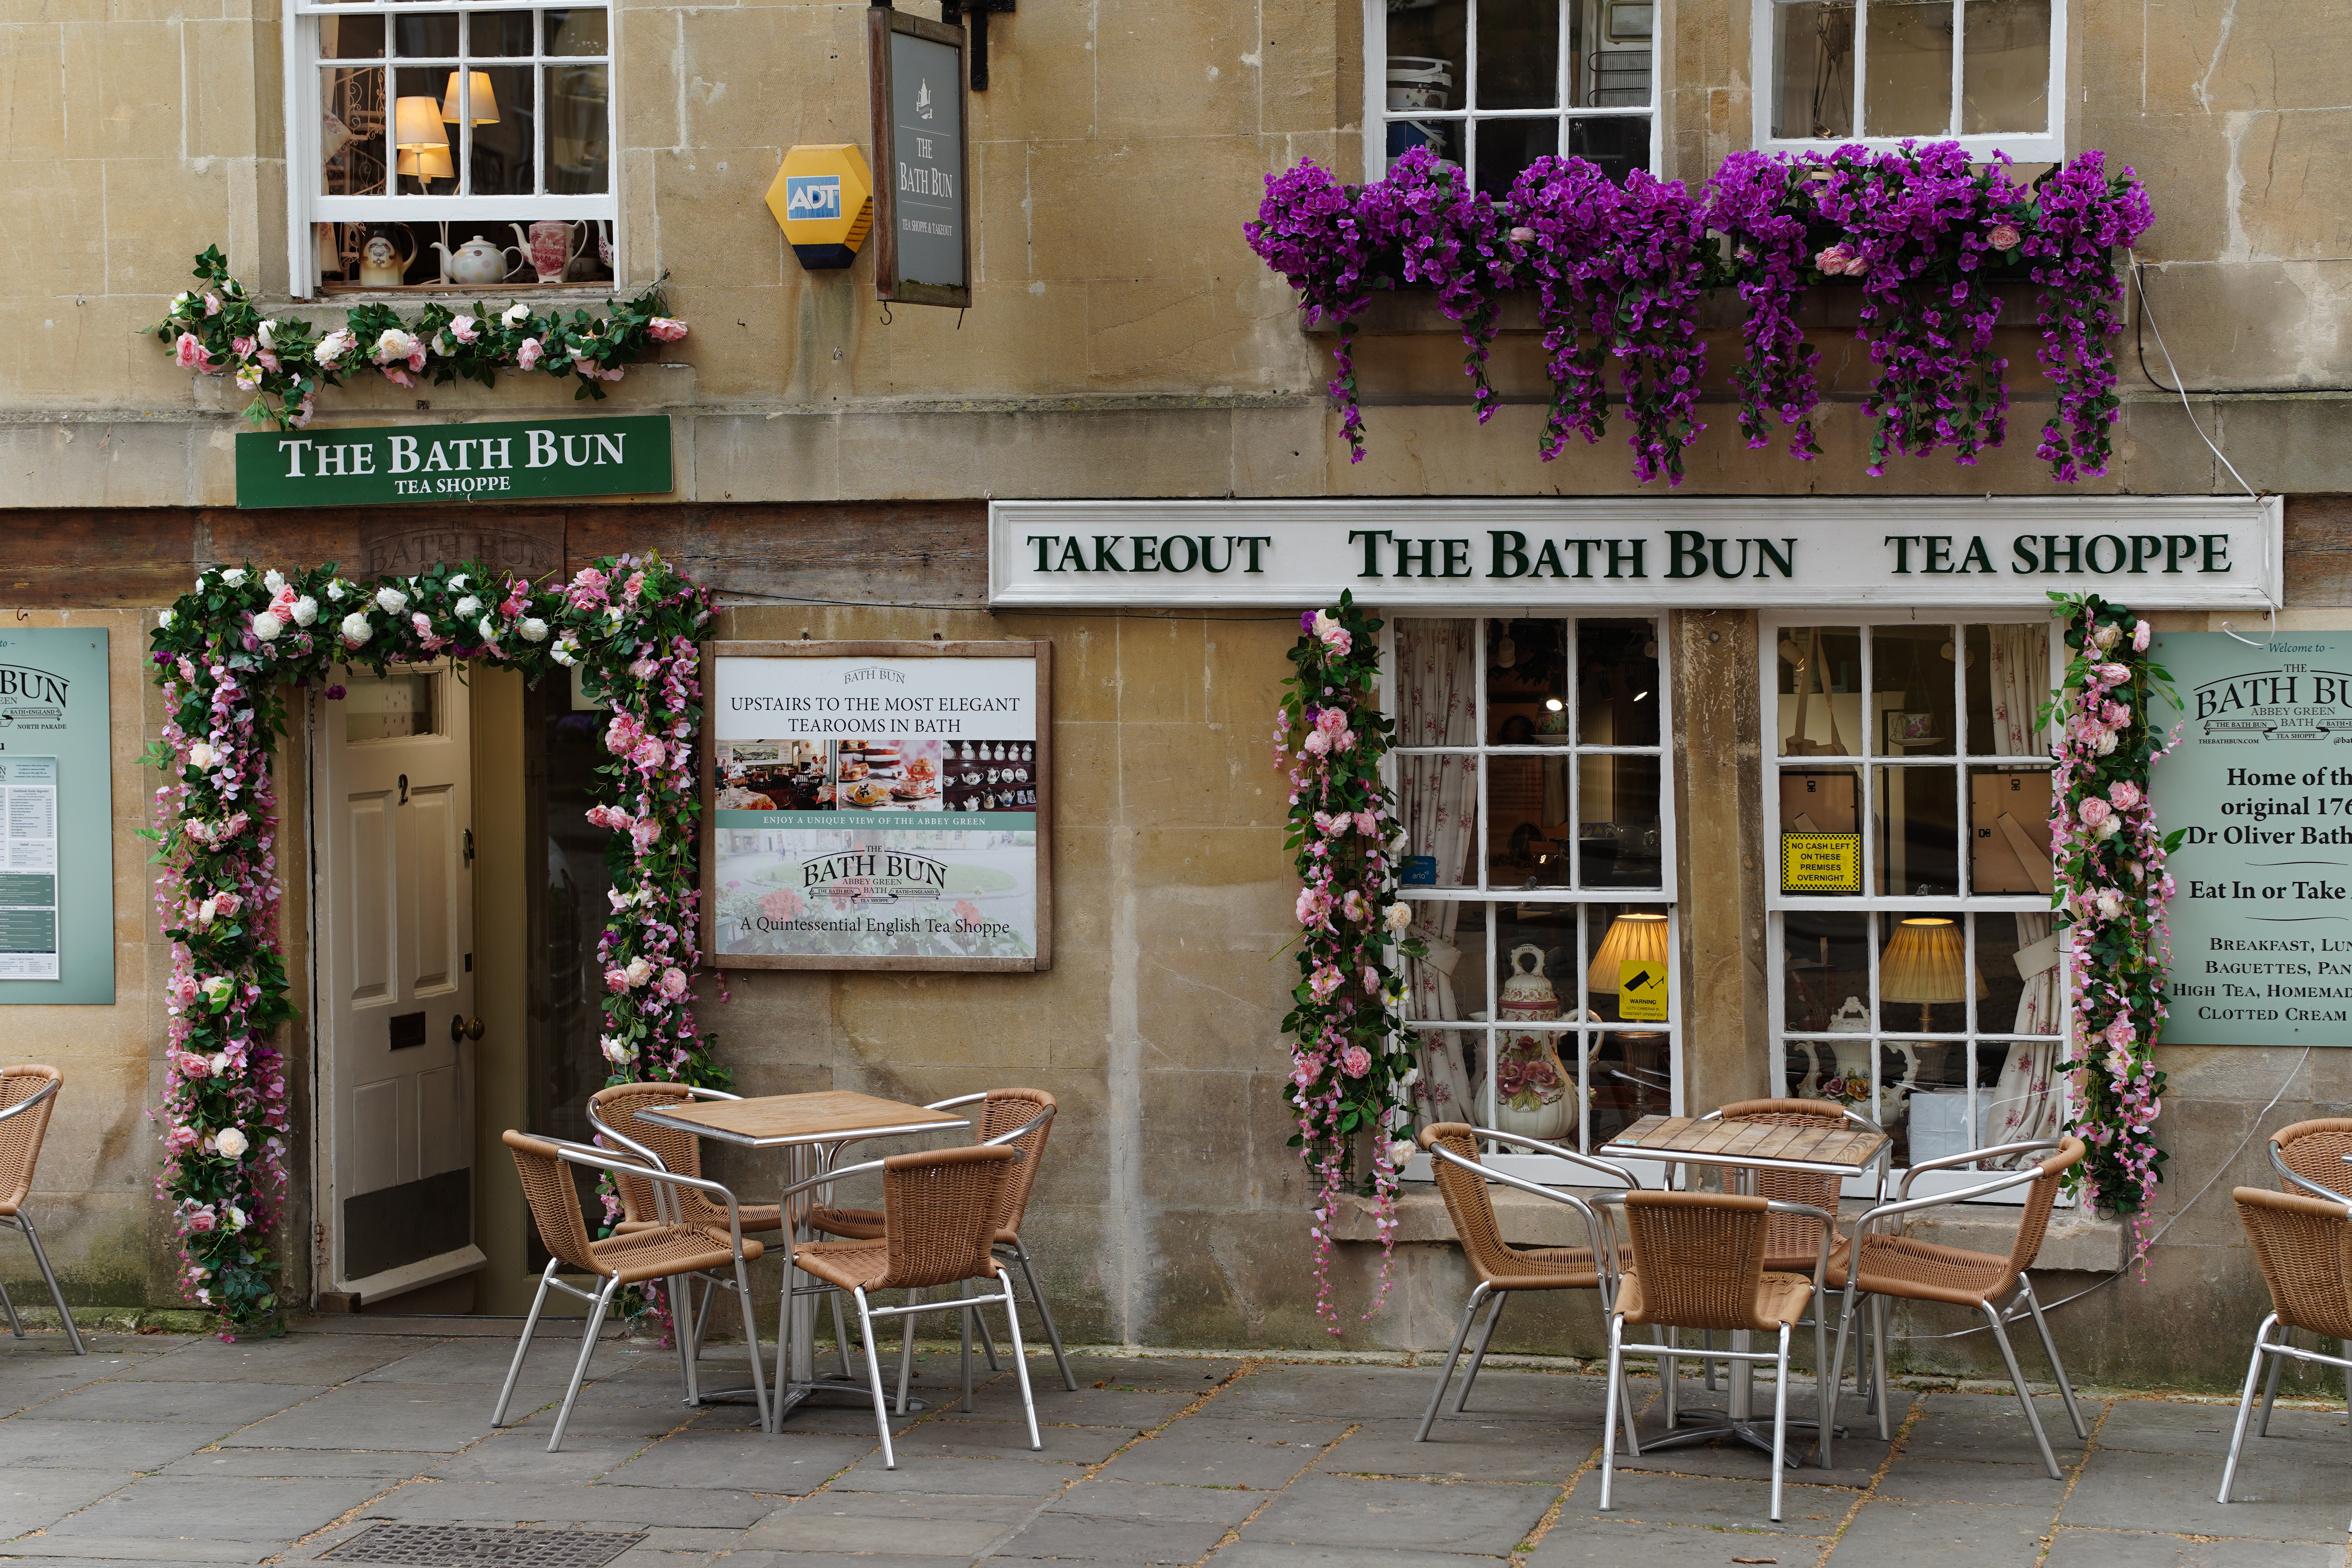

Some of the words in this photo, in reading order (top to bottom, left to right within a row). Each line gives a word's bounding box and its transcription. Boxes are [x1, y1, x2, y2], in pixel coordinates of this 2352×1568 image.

[916, 137, 933, 159] THE
[900, 162, 929, 194] BATH
[931, 167, 952, 198] BUN
[788, 185, 839, 210] ADT
[902, 219, 911, 231] TEA
[912, 220, 927, 233] SHOPPE
[928, 223, 931, 234] &
[932, 223, 952, 236] TAKEOUT
[278, 439, 376, 477] THE
[387, 436, 513, 473] BATH
[525, 430, 626, 468] BUN
[395, 479, 432, 494] TEA
[436, 476, 511, 493] SHOPPE
[450, 521, 471, 530] THE
[367, 533, 463, 576] BATH
[476, 533, 557, 571] BUN
[1027, 535, 1271, 573] TAKEOUT
[1348, 530, 1472, 578] THE
[1485, 530, 1648, 578] BATH
[1663, 530, 1798, 579] BUN
[1884, 535, 1997, 573] TEA
[2011, 534, 2232, 574] SHOPPE
[2269, 642, 2312, 653] Welcome
[2315, 644, 2325, 652] to
[2284, 664, 2307, 672] THE
[844, 670, 875, 685] BATH
[879, 670, 906, 685] BUN
[0, 670, 69, 708] BUN
[731, 697, 811, 711] UPSTAIRS
[815, 697, 839, 711] TO
[844, 697, 880, 711] THE
[884, 698, 934, 711] MOST
[938, 698, 1020, 711] ELEGANT
[2195, 676, 2298, 721] BATH
[2294, 707, 2336, 715] GREEN
[788, 719, 885, 732] TEAROOMS
[890, 719, 909, 732] IN
[915, 719, 961, 732] BATH
[2227, 768, 2296, 786] Home
[2302, 766, 2328, 786] of
[398, 774, 408, 806] 2
[2221, 796, 2310, 822] original
[764, 817, 794, 825] ENJOY
[807, 817, 846, 825] UNIQUE
[2187, 826, 2218, 844] Dr
[2224, 825, 2296, 844] Oliver
[2300, 825, 2352, 844] Bath
[803, 855, 876, 887] BATH
[886, 855, 946, 889] BUN
[2189, 881, 2227, 899] Eat
[2232, 881, 2256, 898] In
[2262, 887, 2287, 899] or
[2292, 880, 2346, 899] Take
[740, 918, 752, 930] A
[756, 916, 861, 933] Quintessential
[867, 918, 920, 936] English
[925, 919, 951, 933] Tea
[955, 920, 1010, 938] Shoppe
[2210, 937, 2315, 953] BREAKFAST,
[2205, 960, 2311, 976] BAGUETTES,
[2172, 984, 2216, 996] HIGH
[2222, 984, 2260, 999] TEA,
[2198, 1006, 2278, 1020] CLOTTED
[2285, 1007, 2347, 1021] CREAM
[436, 1544, 529, 1554] CATV
